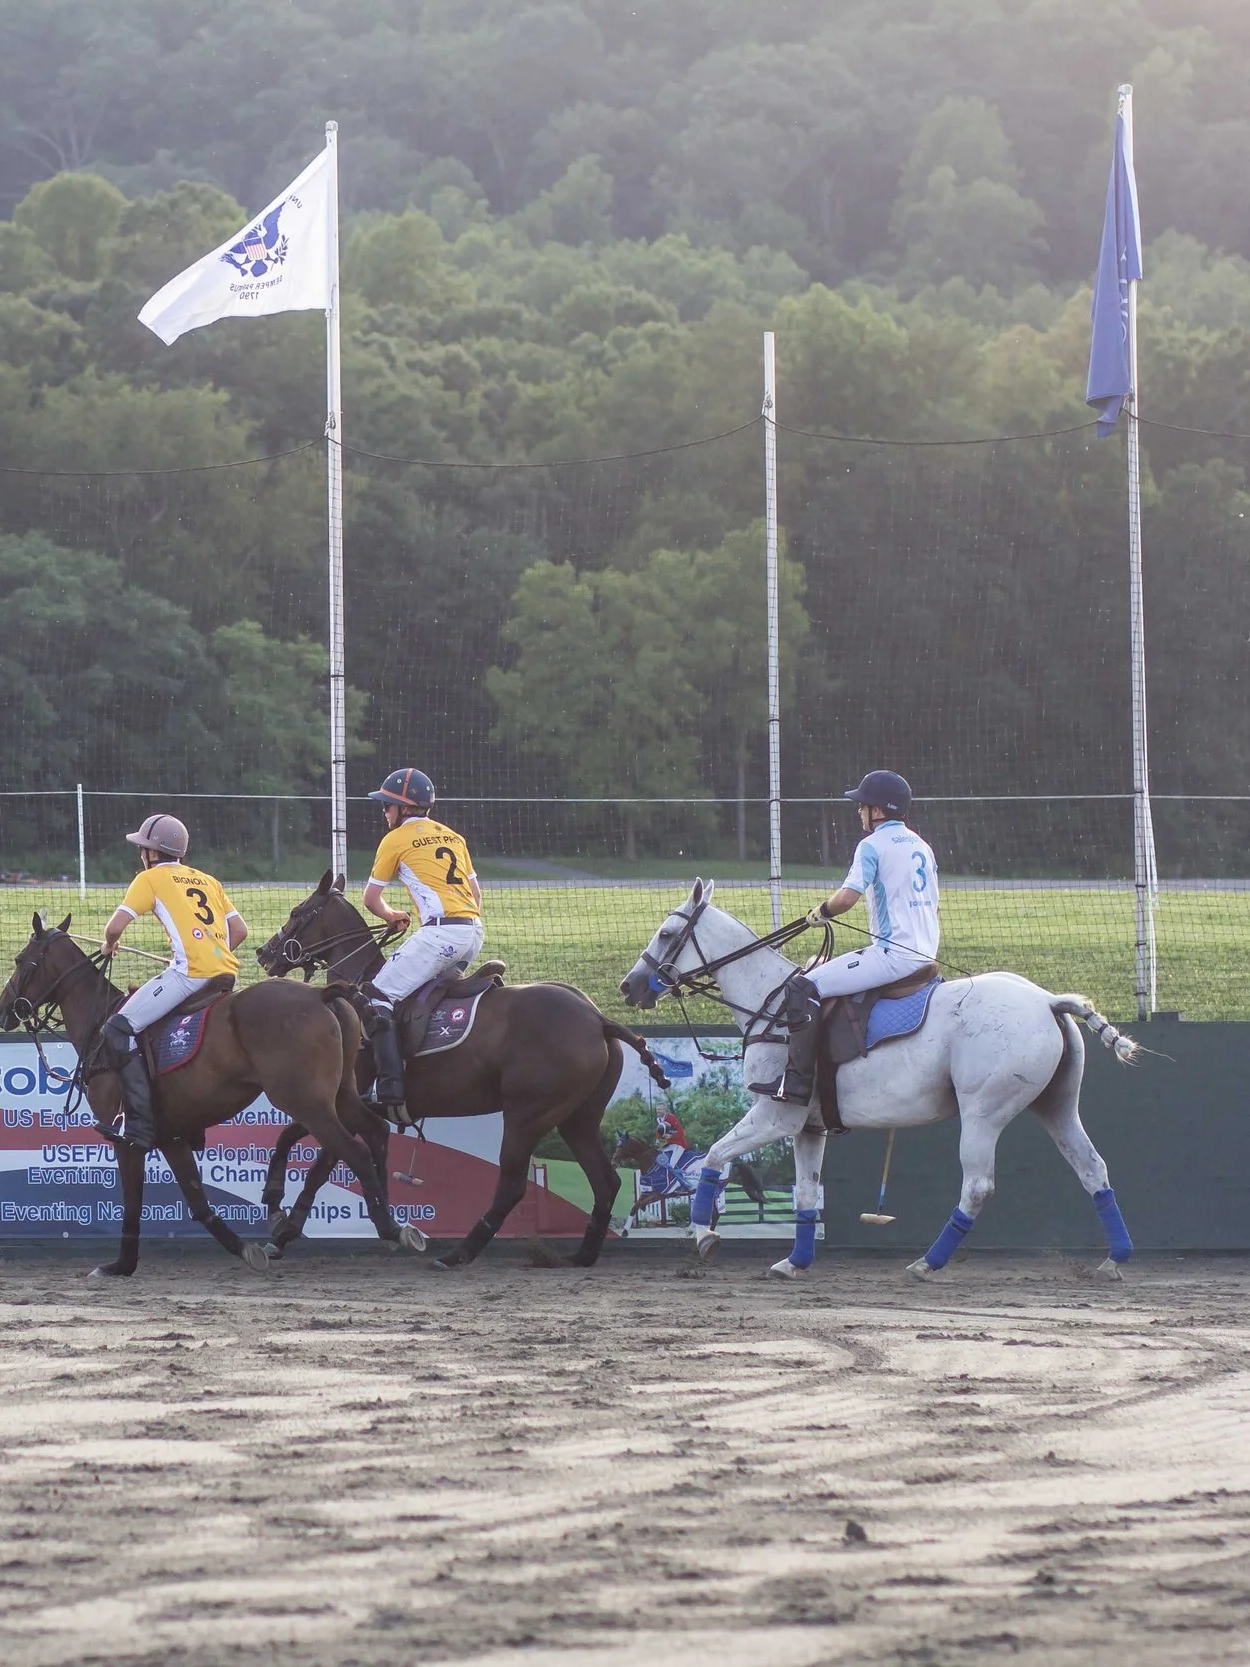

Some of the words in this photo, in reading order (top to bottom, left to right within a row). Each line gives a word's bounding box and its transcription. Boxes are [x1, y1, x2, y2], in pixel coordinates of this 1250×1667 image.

[412, 836, 442, 848] GUEST
[435, 846, 464, 885] 2
[911, 850, 926, 893] 3
[186, 888, 215, 926] 3
[3, 1108, 34, 1128] US
[41, 1144, 161, 1164] USEF/UA
[28, 1166, 116, 1188] Eventing
[1, 1201, 92, 1226] Eventing
[97, 1200, 183, 1221] Naonal
